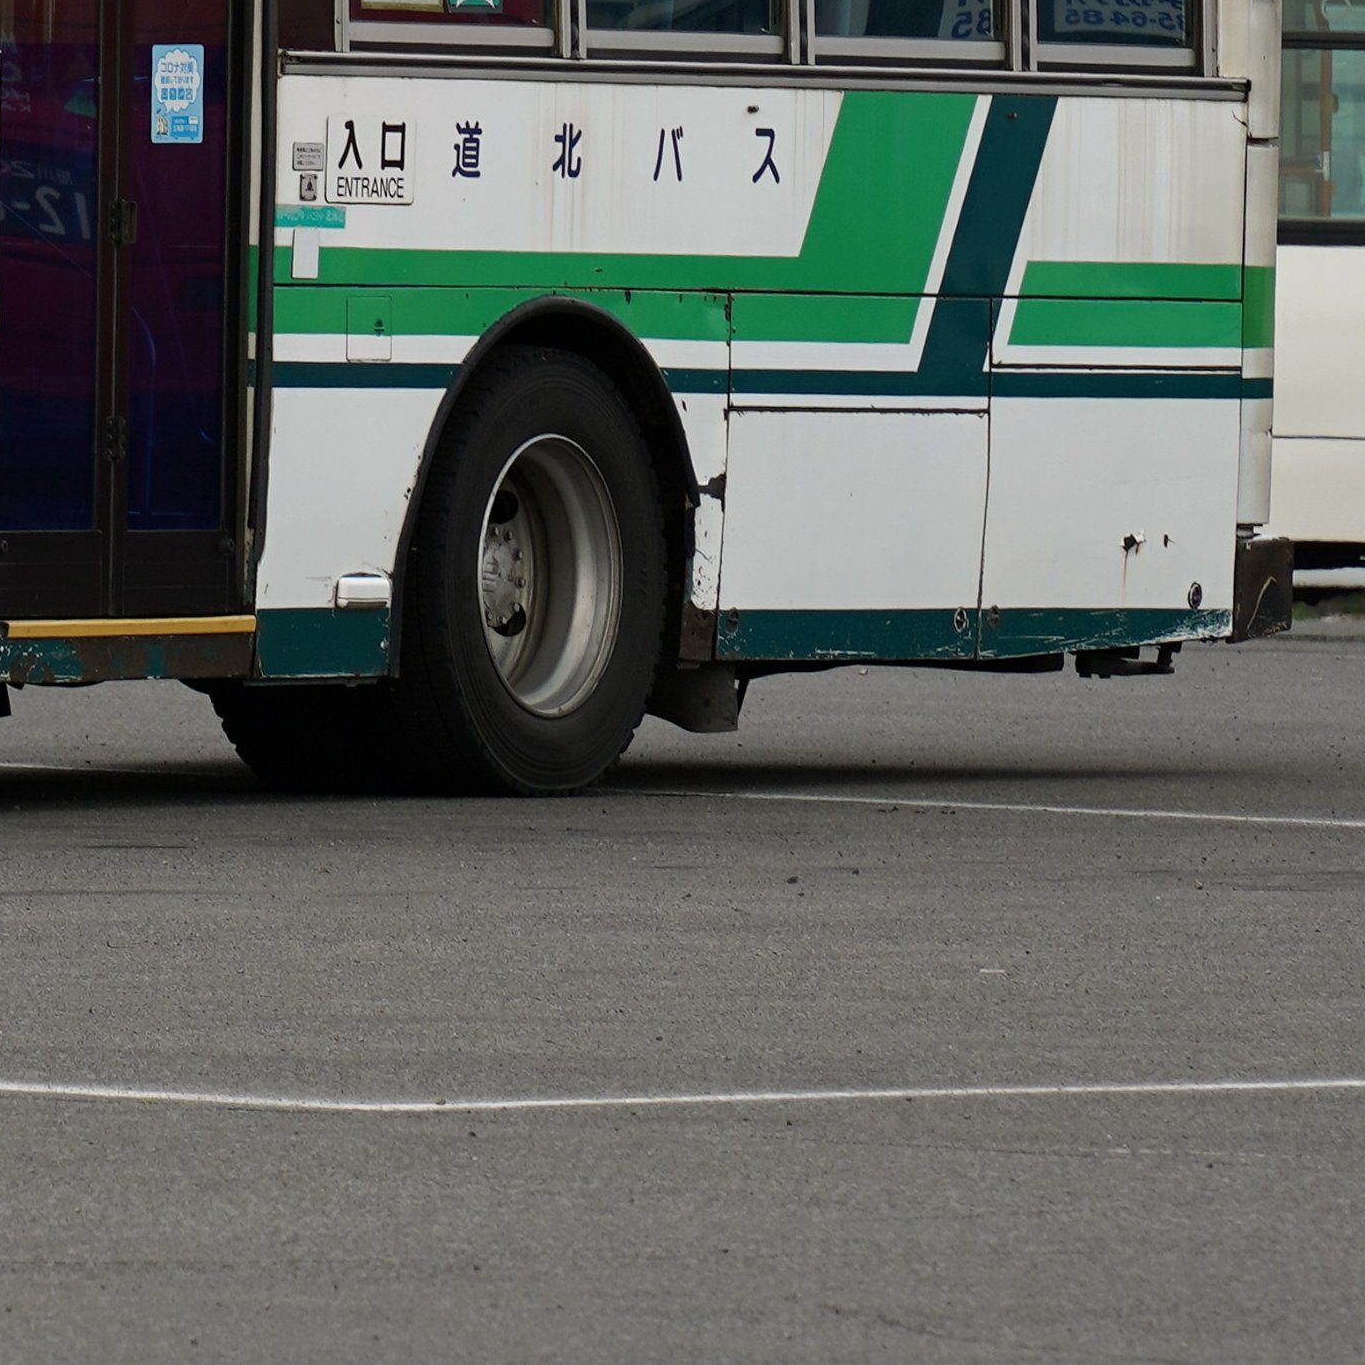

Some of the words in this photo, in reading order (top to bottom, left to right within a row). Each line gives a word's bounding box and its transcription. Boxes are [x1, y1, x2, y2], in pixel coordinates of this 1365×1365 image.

[337, 120, 407, 171] 入口
[451, 120, 781, 185] 道北バス
[337, 176, 405, 199] ENTRANCE
